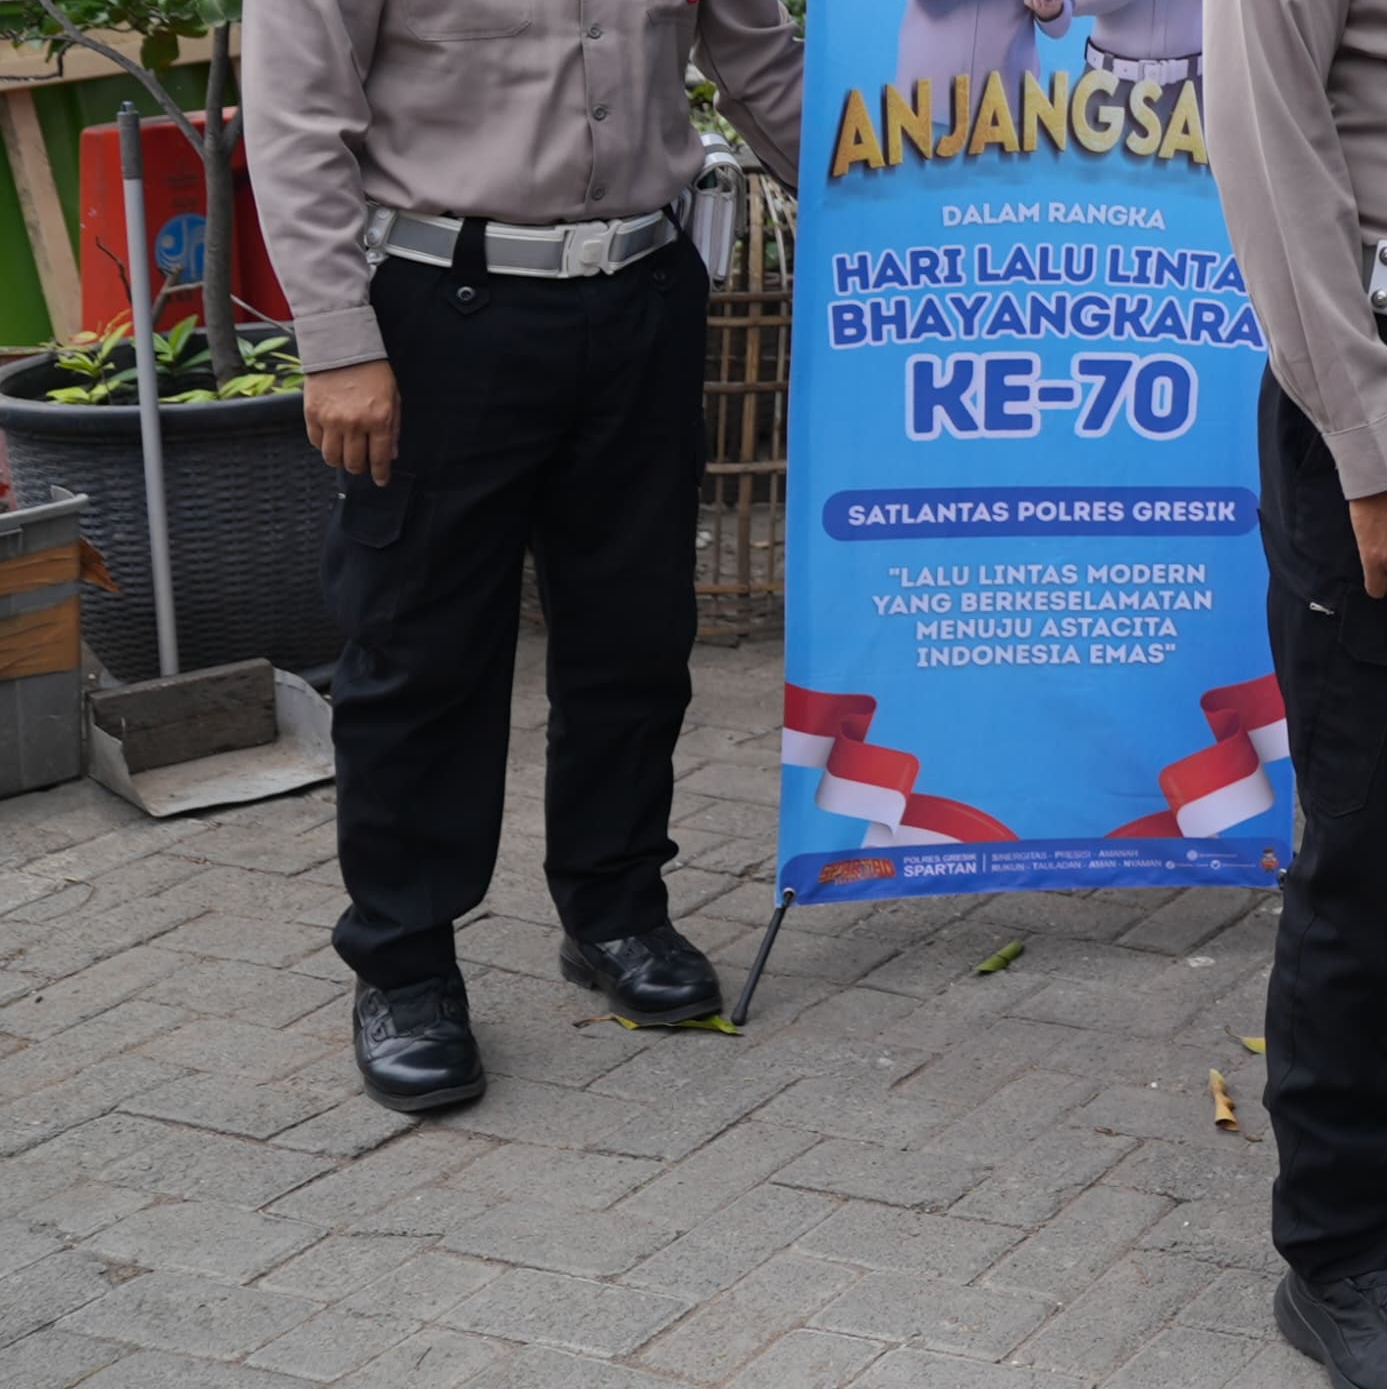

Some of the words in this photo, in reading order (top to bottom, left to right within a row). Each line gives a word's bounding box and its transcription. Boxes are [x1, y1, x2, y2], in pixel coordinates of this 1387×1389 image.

[833, 69, 1209, 177] ANJANGSA
[942, 203, 1040, 228] DALAM
[1048, 203, 1167, 230] RANGKA
[833, 246, 963, 295] HARI
[975, 244, 1095, 286] LALU
[1106, 245, 1247, 293] LINTA
[829, 291, 1267, 350] BHAYANGKARA
[906, 352, 1199, 441] KE-70
[847, 503, 1010, 527] SATLANTAS
[1017, 501, 1125, 523] POLRES
[1132, 501, 1236, 523] GRESIK
[888, 564, 971, 589] "LALU
[979, 564, 1079, 586] LINTAS
[1087, 563, 1206, 585] MODERN
[872, 593, 953, 616] YANG
[961, 590, 1213, 613] BERKESELAMATAN
[915, 618, 1034, 641] MENUJU
[1039, 616, 1178, 638] ASTACITA
[916, 644, 1082, 668] INDONESIA
[1089, 643, 1176, 665] EMAS"
[904, 862, 977, 877] SPARTAN
